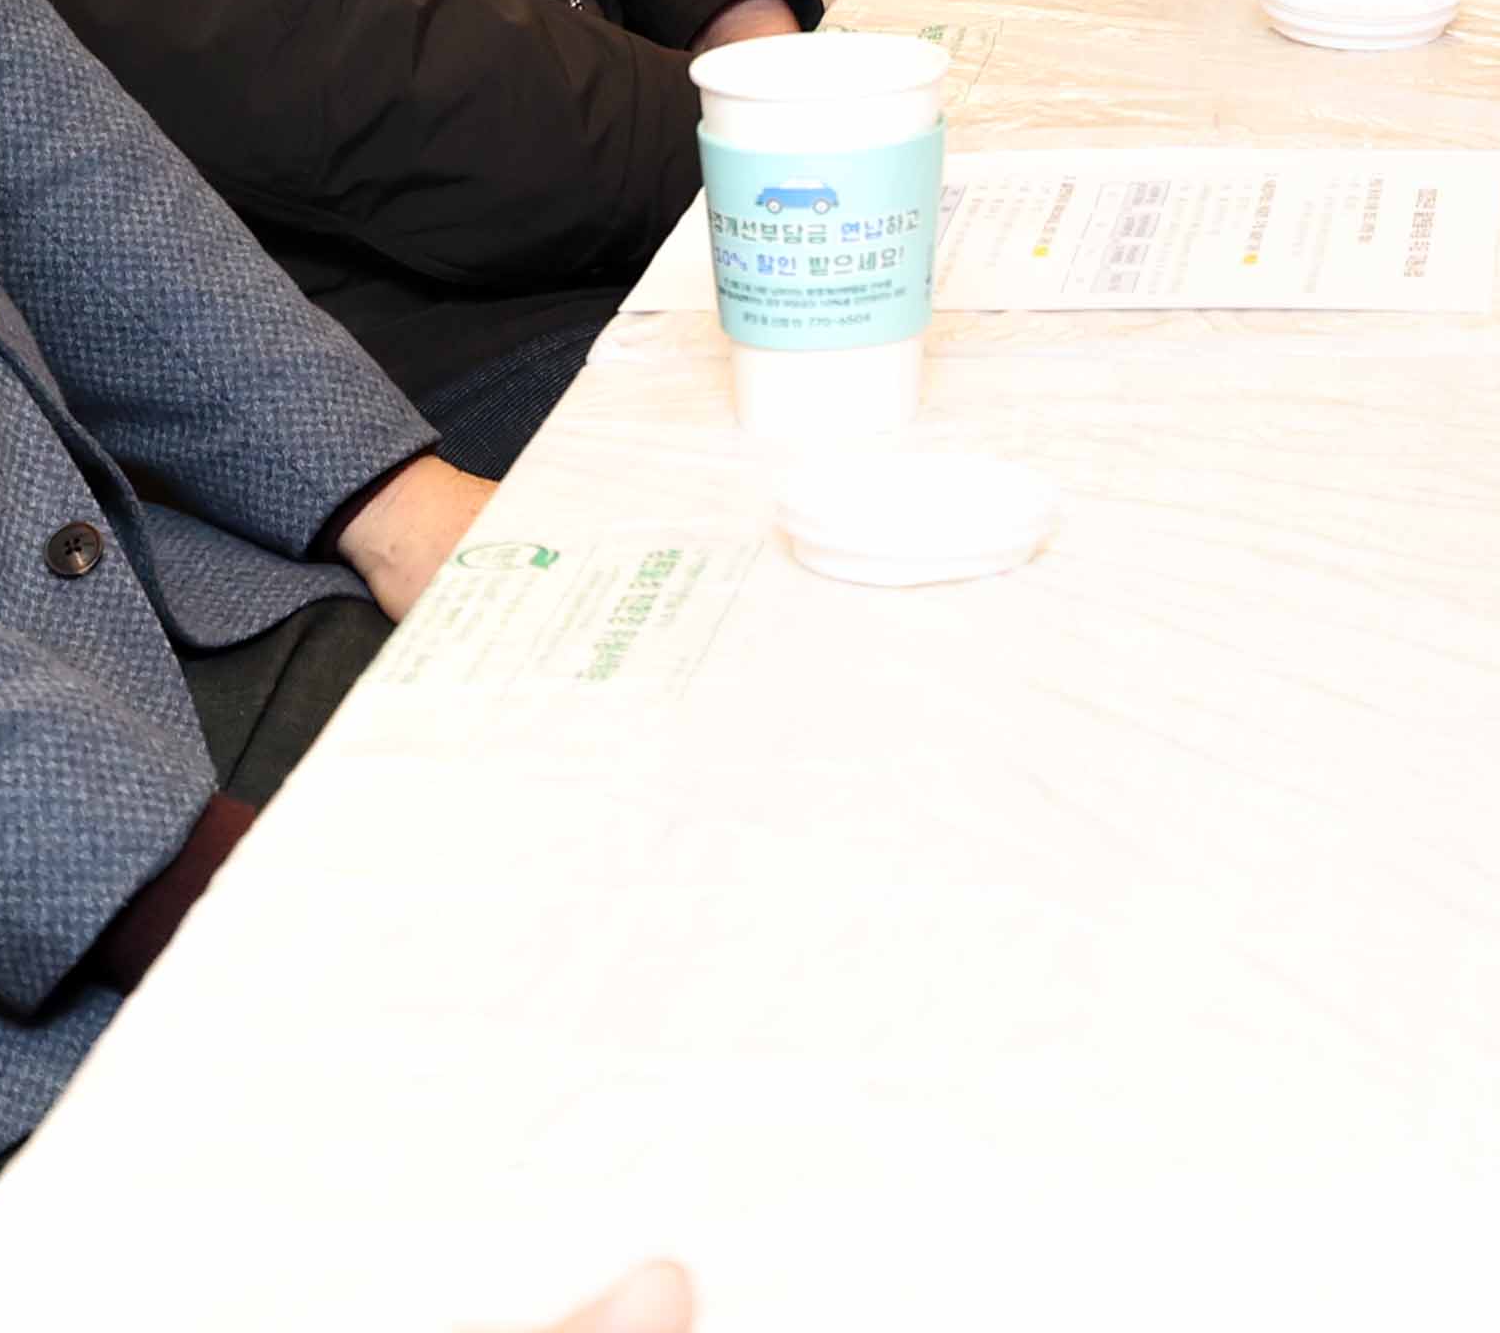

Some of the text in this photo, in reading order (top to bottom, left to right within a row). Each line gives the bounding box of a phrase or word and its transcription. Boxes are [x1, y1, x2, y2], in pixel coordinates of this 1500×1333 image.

[840, 209, 920, 244] 연납하고
[756, 252, 797, 277] 할인
[808, 246, 906, 277] 받으세요!
